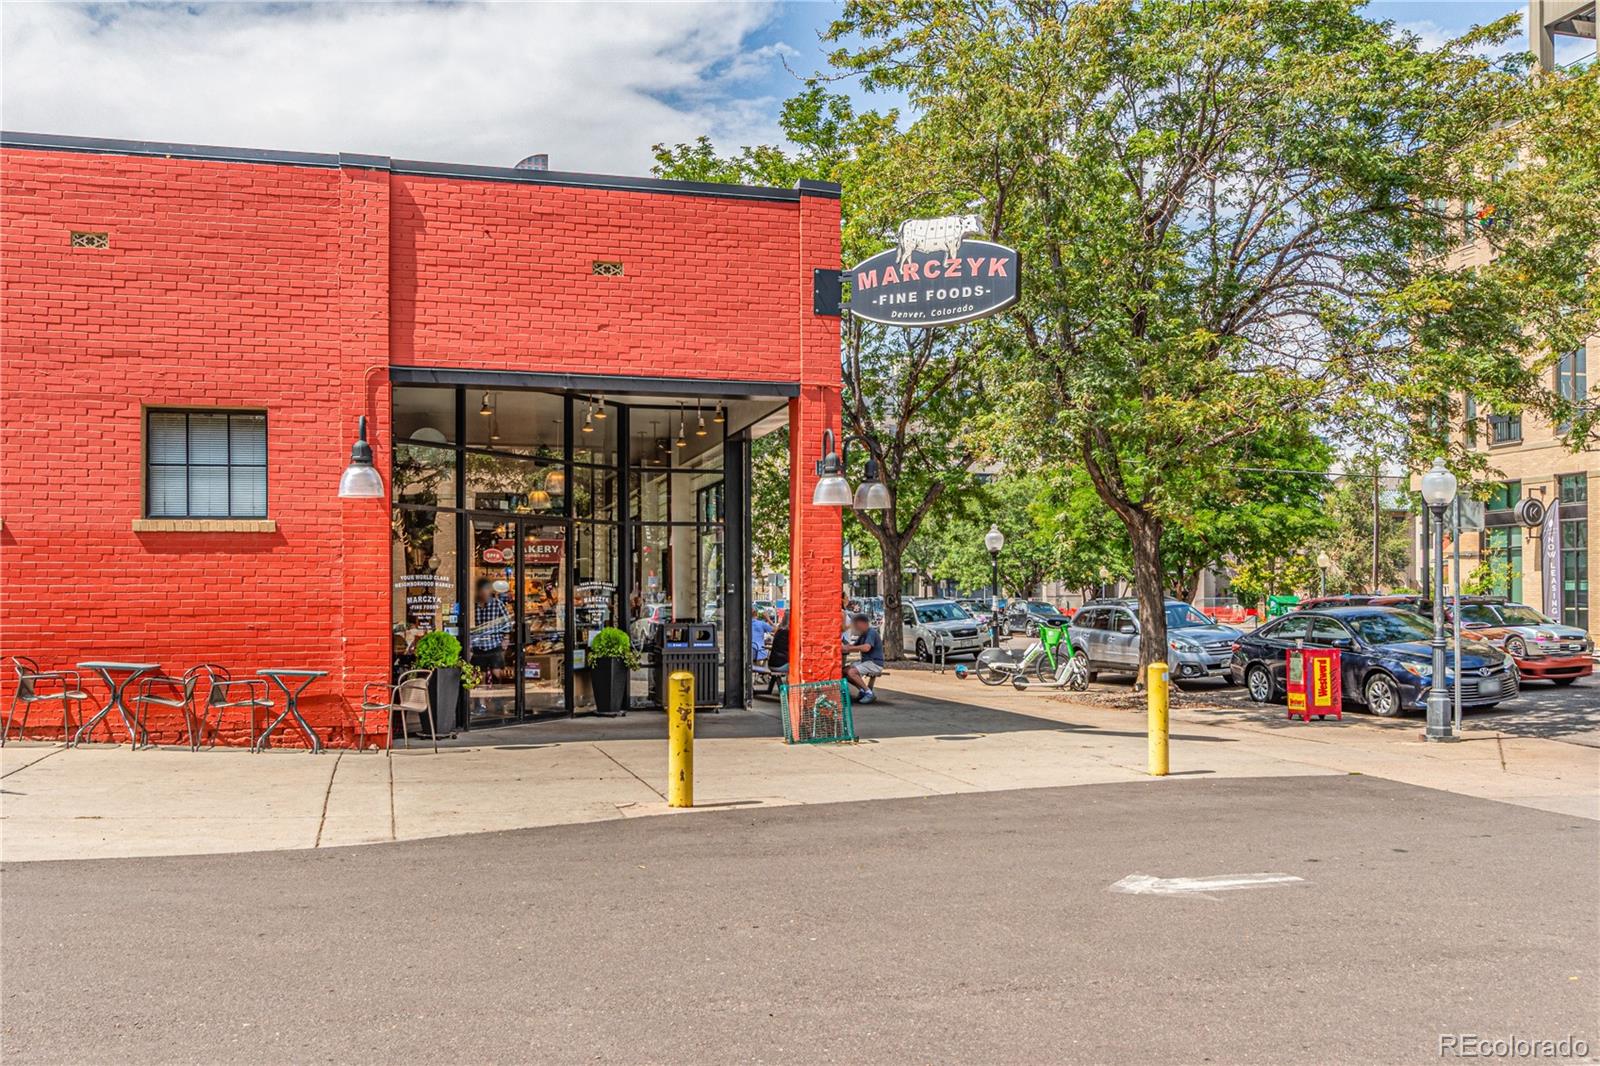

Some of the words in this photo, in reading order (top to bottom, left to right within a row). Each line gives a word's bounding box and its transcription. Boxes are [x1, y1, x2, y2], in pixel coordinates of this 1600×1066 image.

[857, 257, 1010, 291] MARCZYK
[890, 309, 926, 319] Denver,
[930, 304, 975, 318] Colorado
[512, 545, 560, 554] KERY
[1550, 561, 1558, 614] LEASING
[406, 596, 442, 604] MARCZYK
[1316, 659, 1328, 697] Westword
